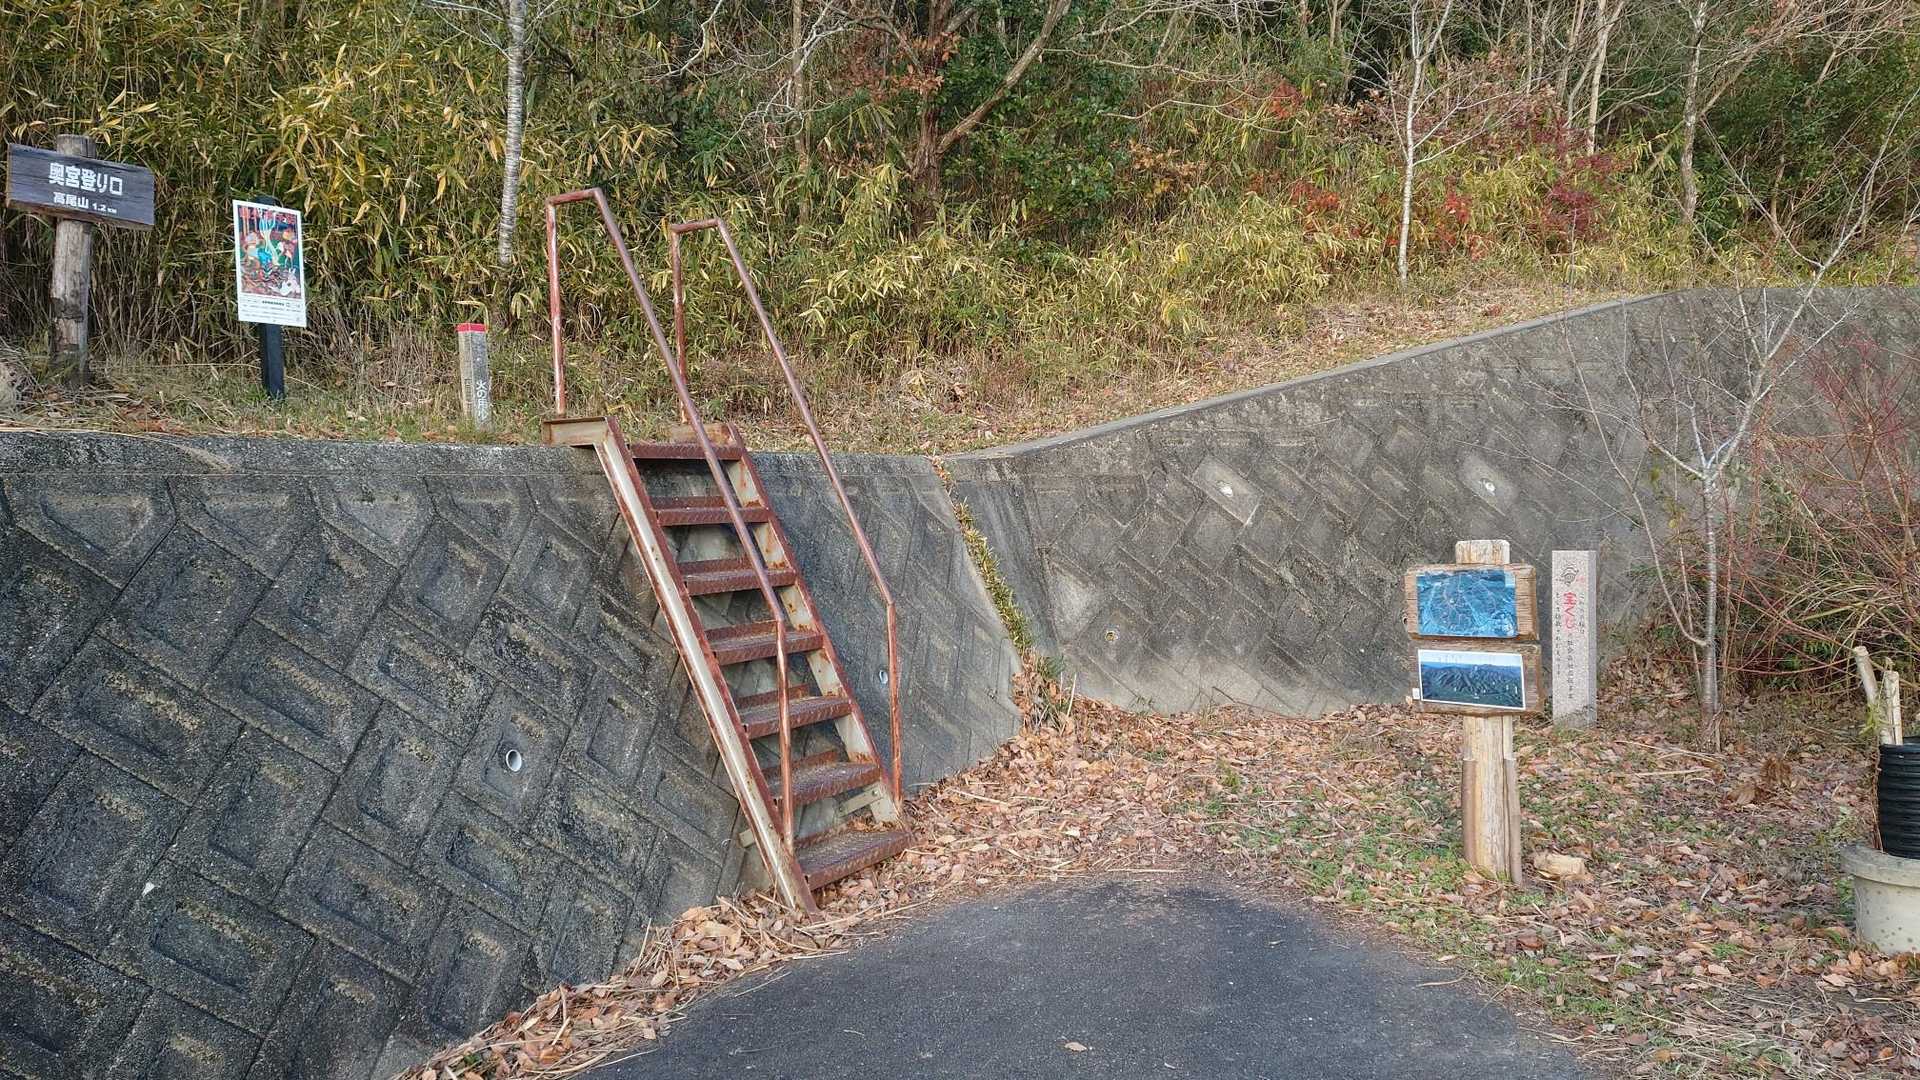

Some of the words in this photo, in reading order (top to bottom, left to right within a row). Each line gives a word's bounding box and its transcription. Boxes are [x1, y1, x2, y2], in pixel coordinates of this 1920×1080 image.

[48, 162, 123, 196] 奥宮登り口
[53, 191, 89, 209] 高尾山
[92, 202, 107, 212] 1.2
